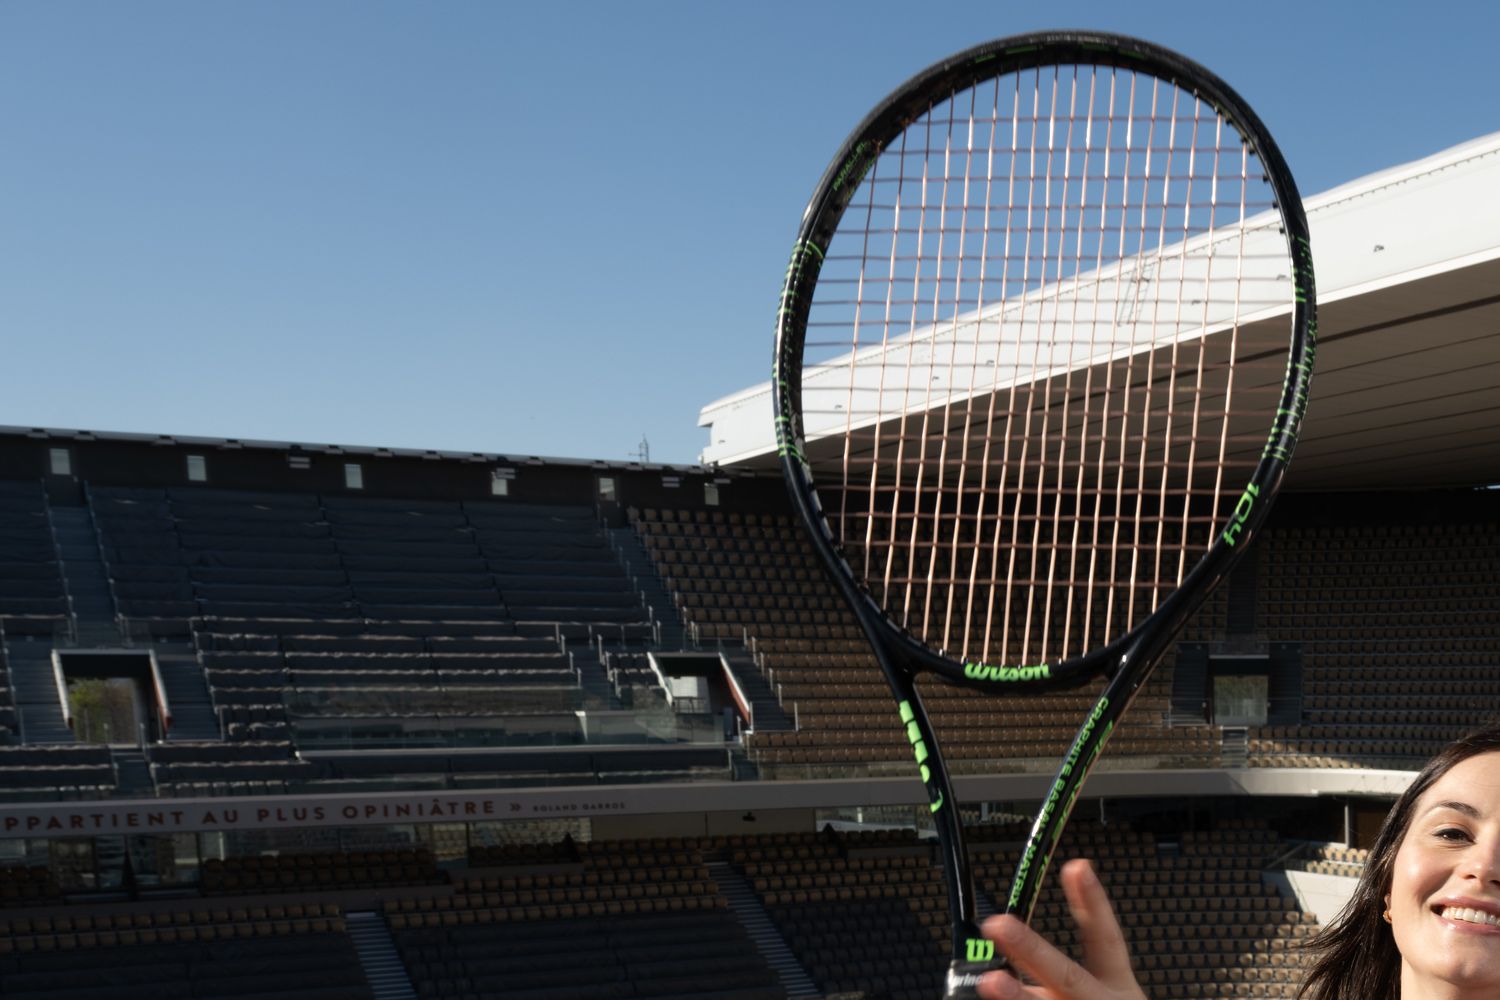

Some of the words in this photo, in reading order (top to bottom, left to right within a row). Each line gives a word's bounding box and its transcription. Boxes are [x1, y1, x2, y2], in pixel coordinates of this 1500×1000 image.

[1222, 481, 1260, 547] 104
[202, 810, 239, 824] AU
[257, 807, 326, 822] PLUS
[343, 799, 494, 818] OPINIÂTRE
